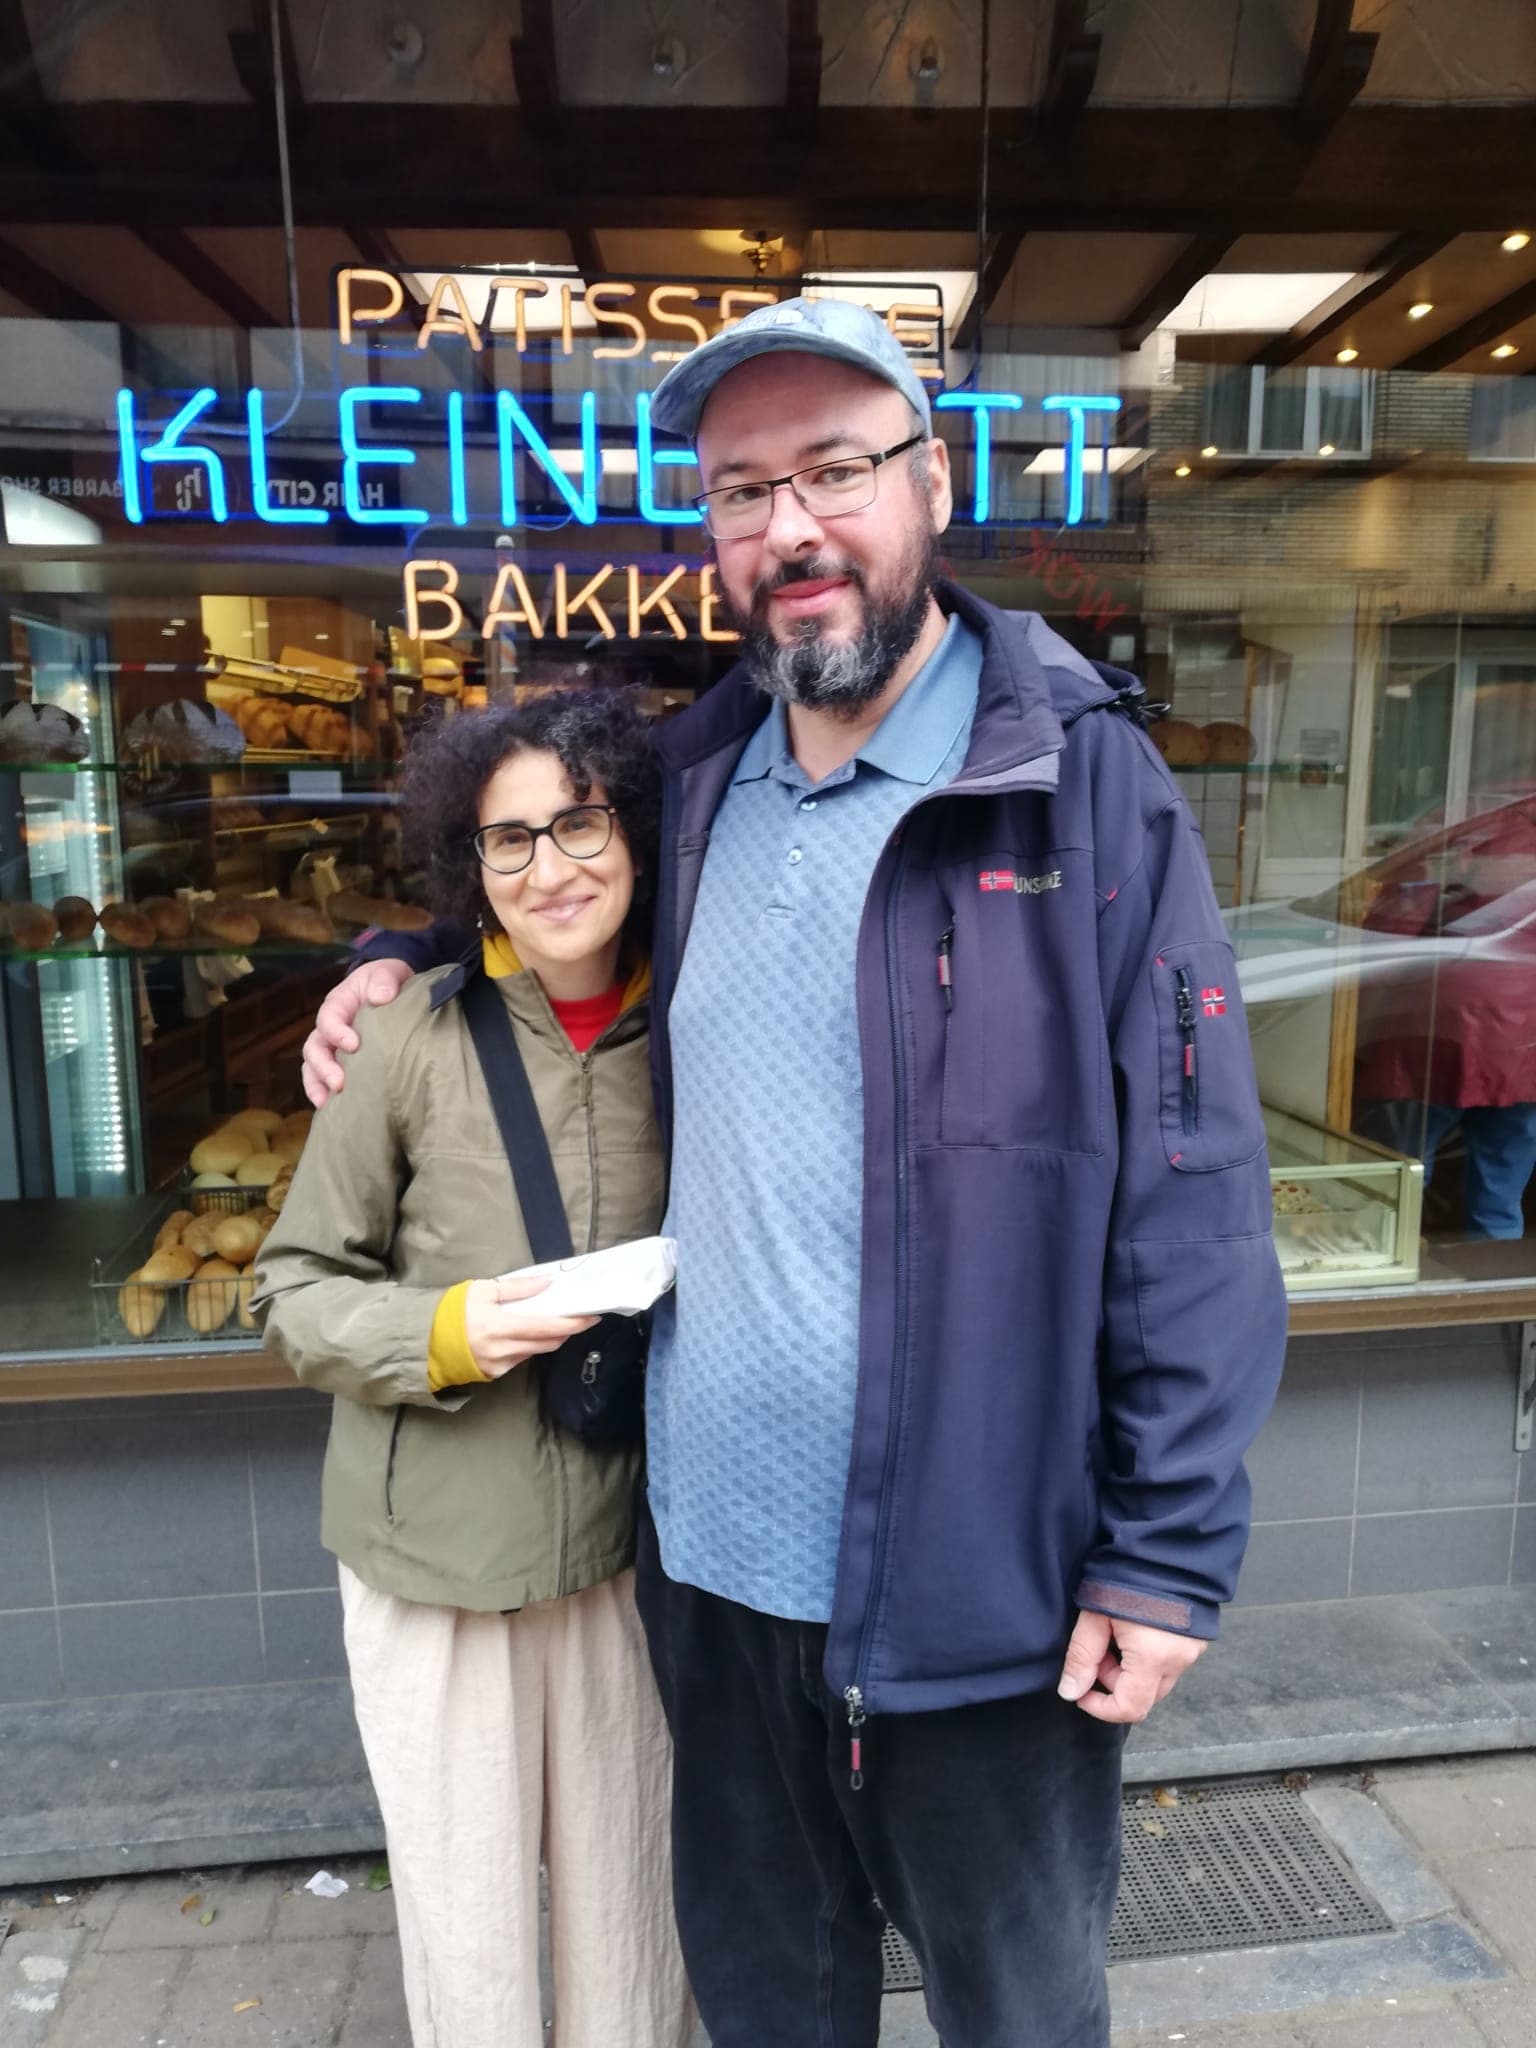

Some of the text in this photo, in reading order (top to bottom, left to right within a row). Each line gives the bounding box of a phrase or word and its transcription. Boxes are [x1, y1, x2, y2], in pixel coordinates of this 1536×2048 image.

[336, 267, 944, 380] PATISSE
[116, 387, 1122, 526] KLEINTT
[403, 559, 744, 641] BAKKE
